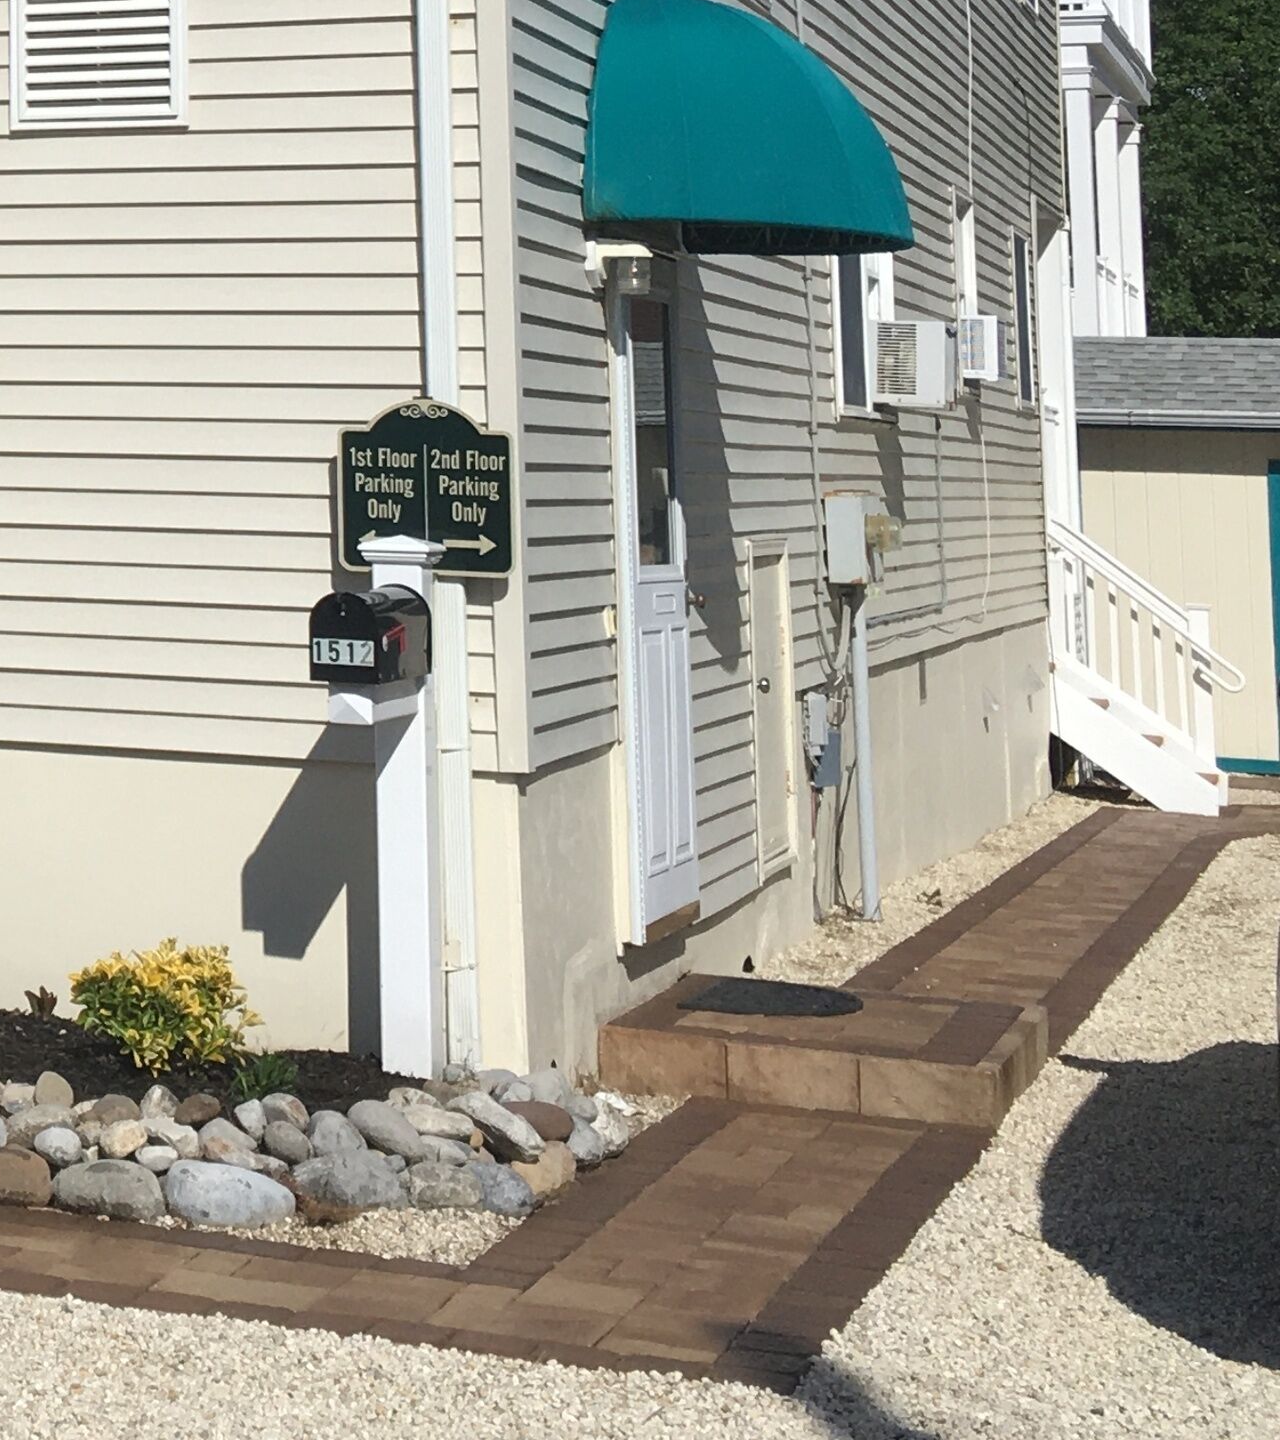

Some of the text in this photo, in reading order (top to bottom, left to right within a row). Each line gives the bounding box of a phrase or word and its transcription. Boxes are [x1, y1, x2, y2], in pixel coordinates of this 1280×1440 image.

[349, 447, 417, 469] 1st Floor
[430, 449, 506, 472] 2nd Floor
[354, 473, 415, 498] Parking
[439, 475, 500, 501] Parking
[367, 498, 401, 523] Only
[451, 501, 487, 527] Only
[313, 639, 374, 664] 1512
